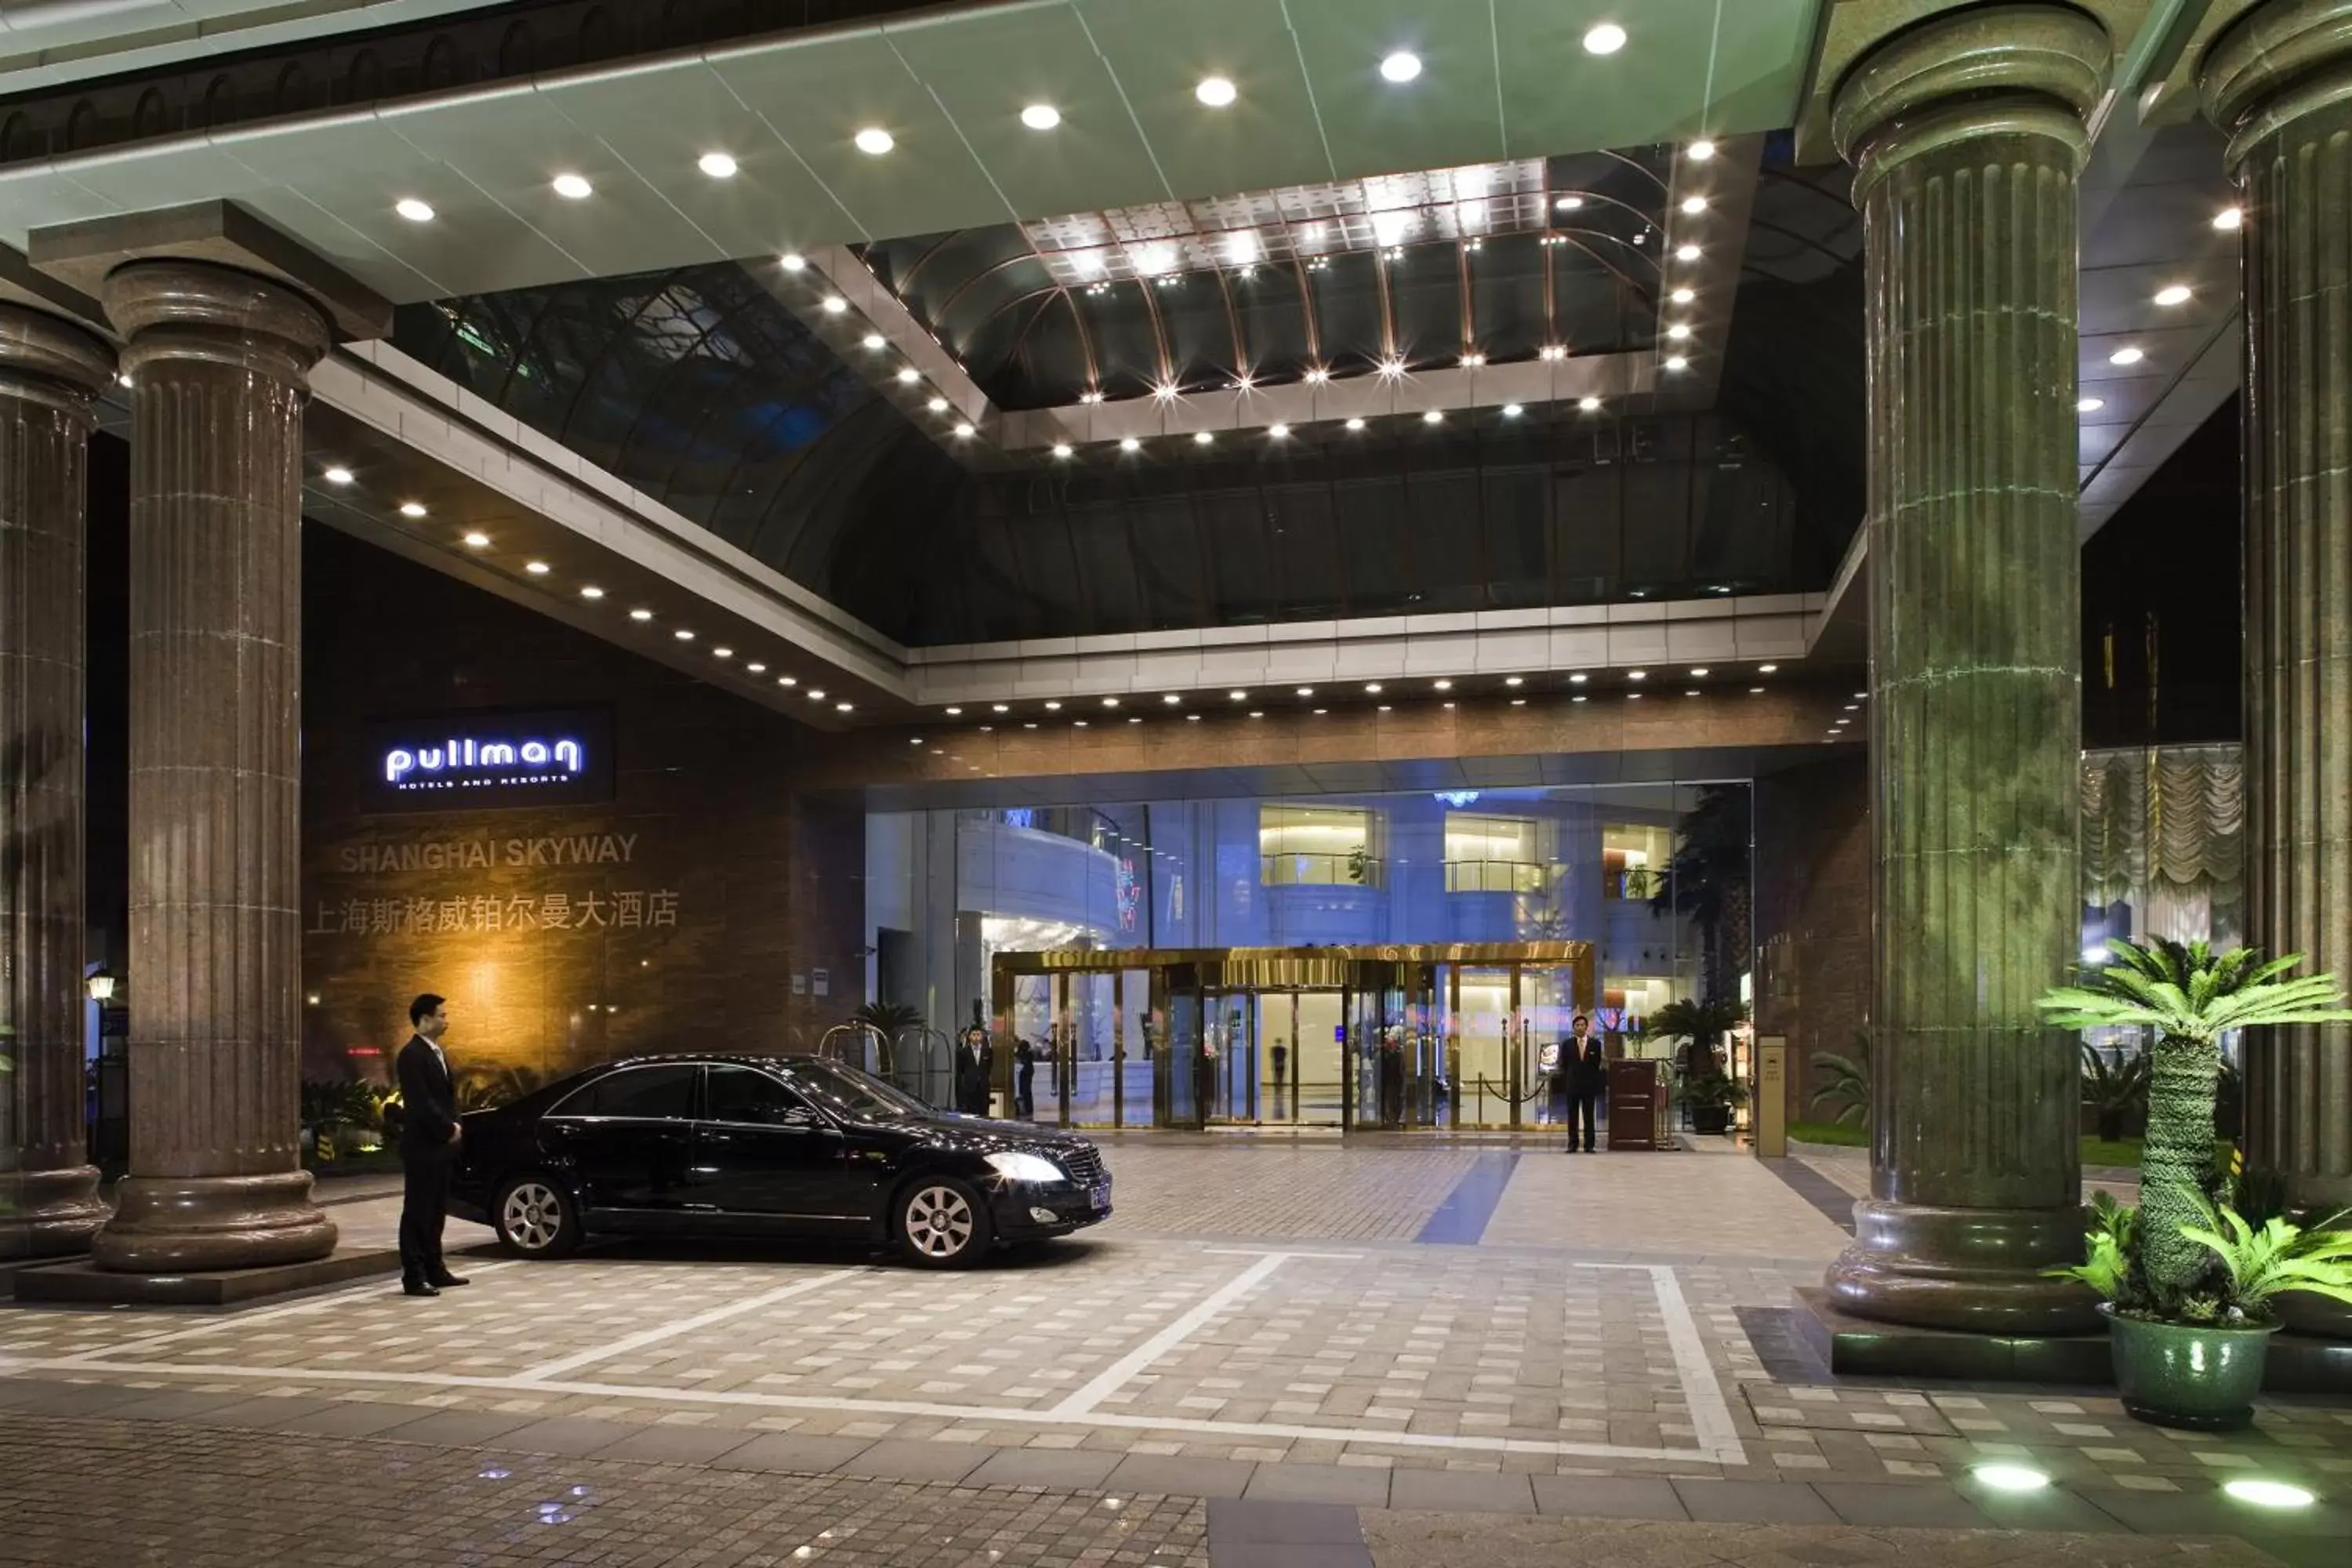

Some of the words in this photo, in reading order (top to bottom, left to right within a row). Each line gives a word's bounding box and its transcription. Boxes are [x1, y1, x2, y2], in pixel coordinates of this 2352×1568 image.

[387, 739, 582, 781] pullman
[399, 781, 454, 790] HOTELS
[462, 779, 492, 787] AND
[500, 775, 569, 785] RESORTS
[340, 841, 496, 873] SHANGHAI
[506, 833, 638, 867] SKYWAY
[307, 888, 681, 935] 上海斯格威铂尔曼大酒店
